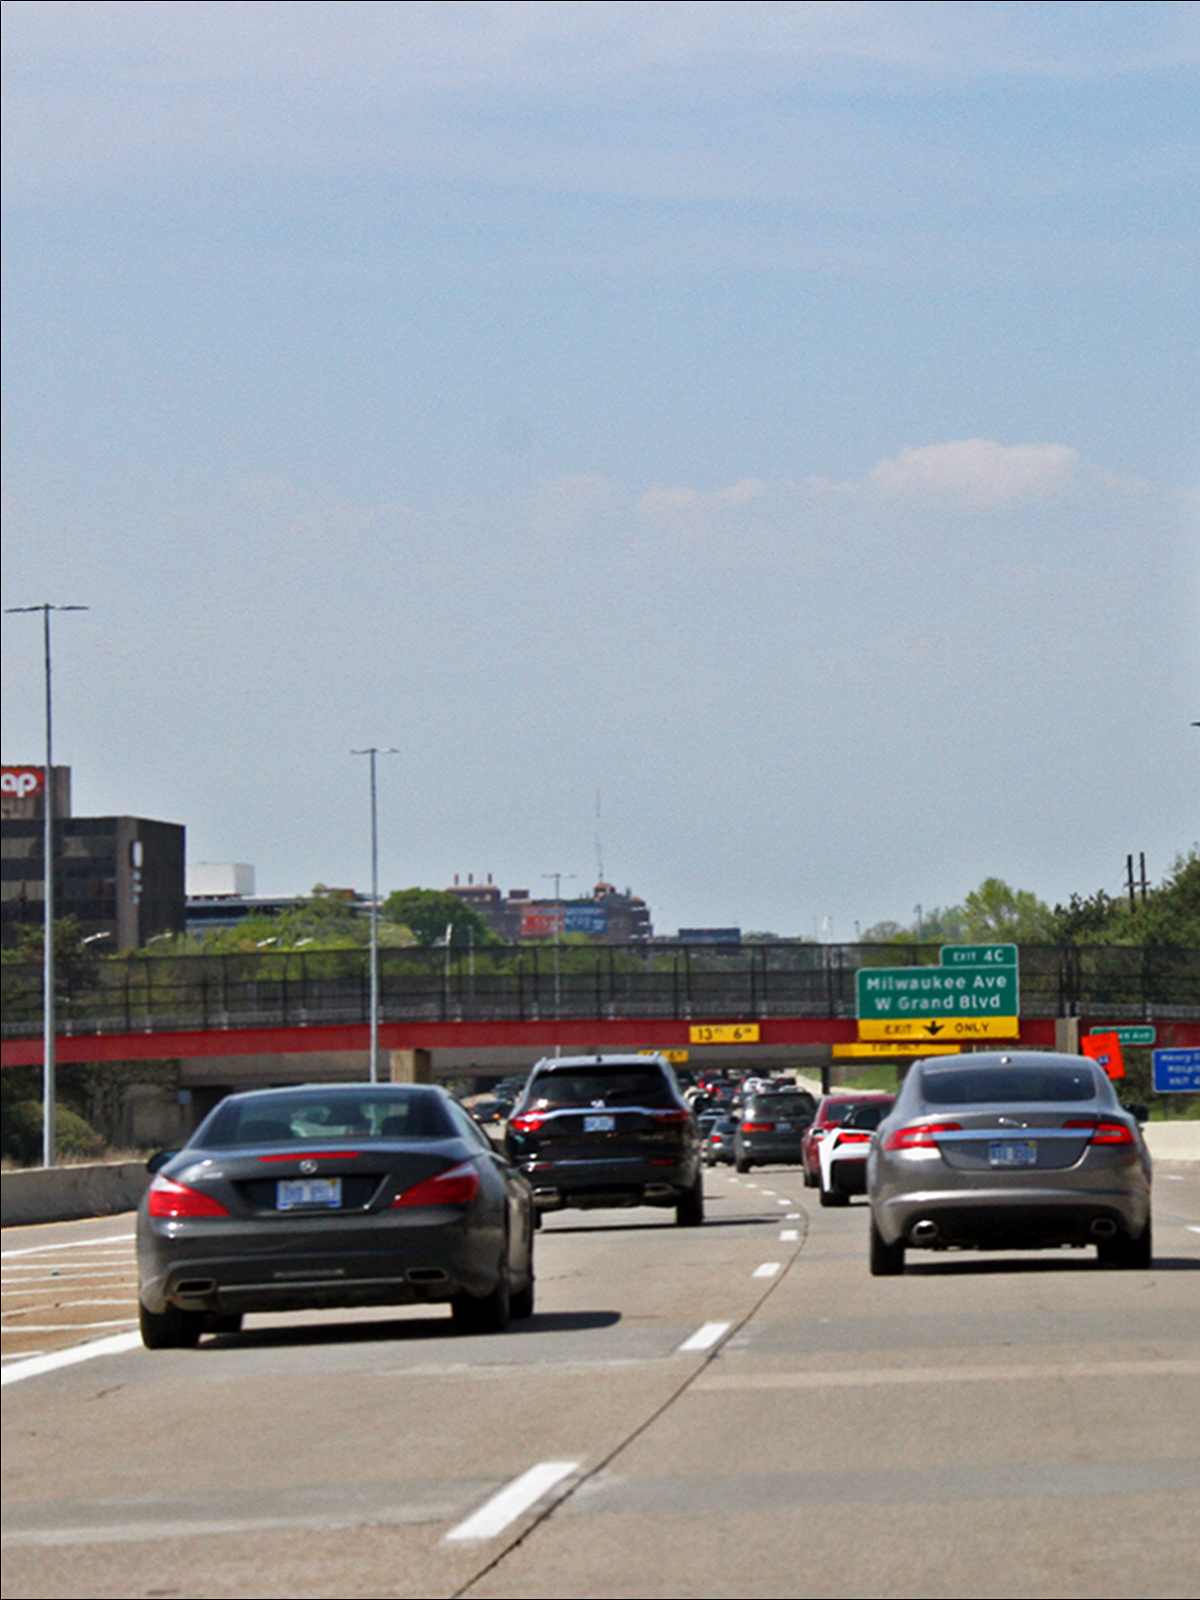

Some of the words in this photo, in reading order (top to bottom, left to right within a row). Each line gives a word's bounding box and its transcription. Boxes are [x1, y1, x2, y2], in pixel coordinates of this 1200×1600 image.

[952, 951, 976, 962] EXIT
[983, 949, 1004, 962] 4C
[866, 976, 966, 991] Milwaukee
[973, 975, 1007, 988] Ave
[875, 997, 892, 1010] W
[897, 995, 954, 1010] Grand
[959, 994, 1001, 1009] Blvd
[698, 1028, 713, 1040] 13
[733, 1027, 743, 1040] 6
[884, 1024, 912, 1035] EXIT
[955, 1022, 990, 1034] ONLY
